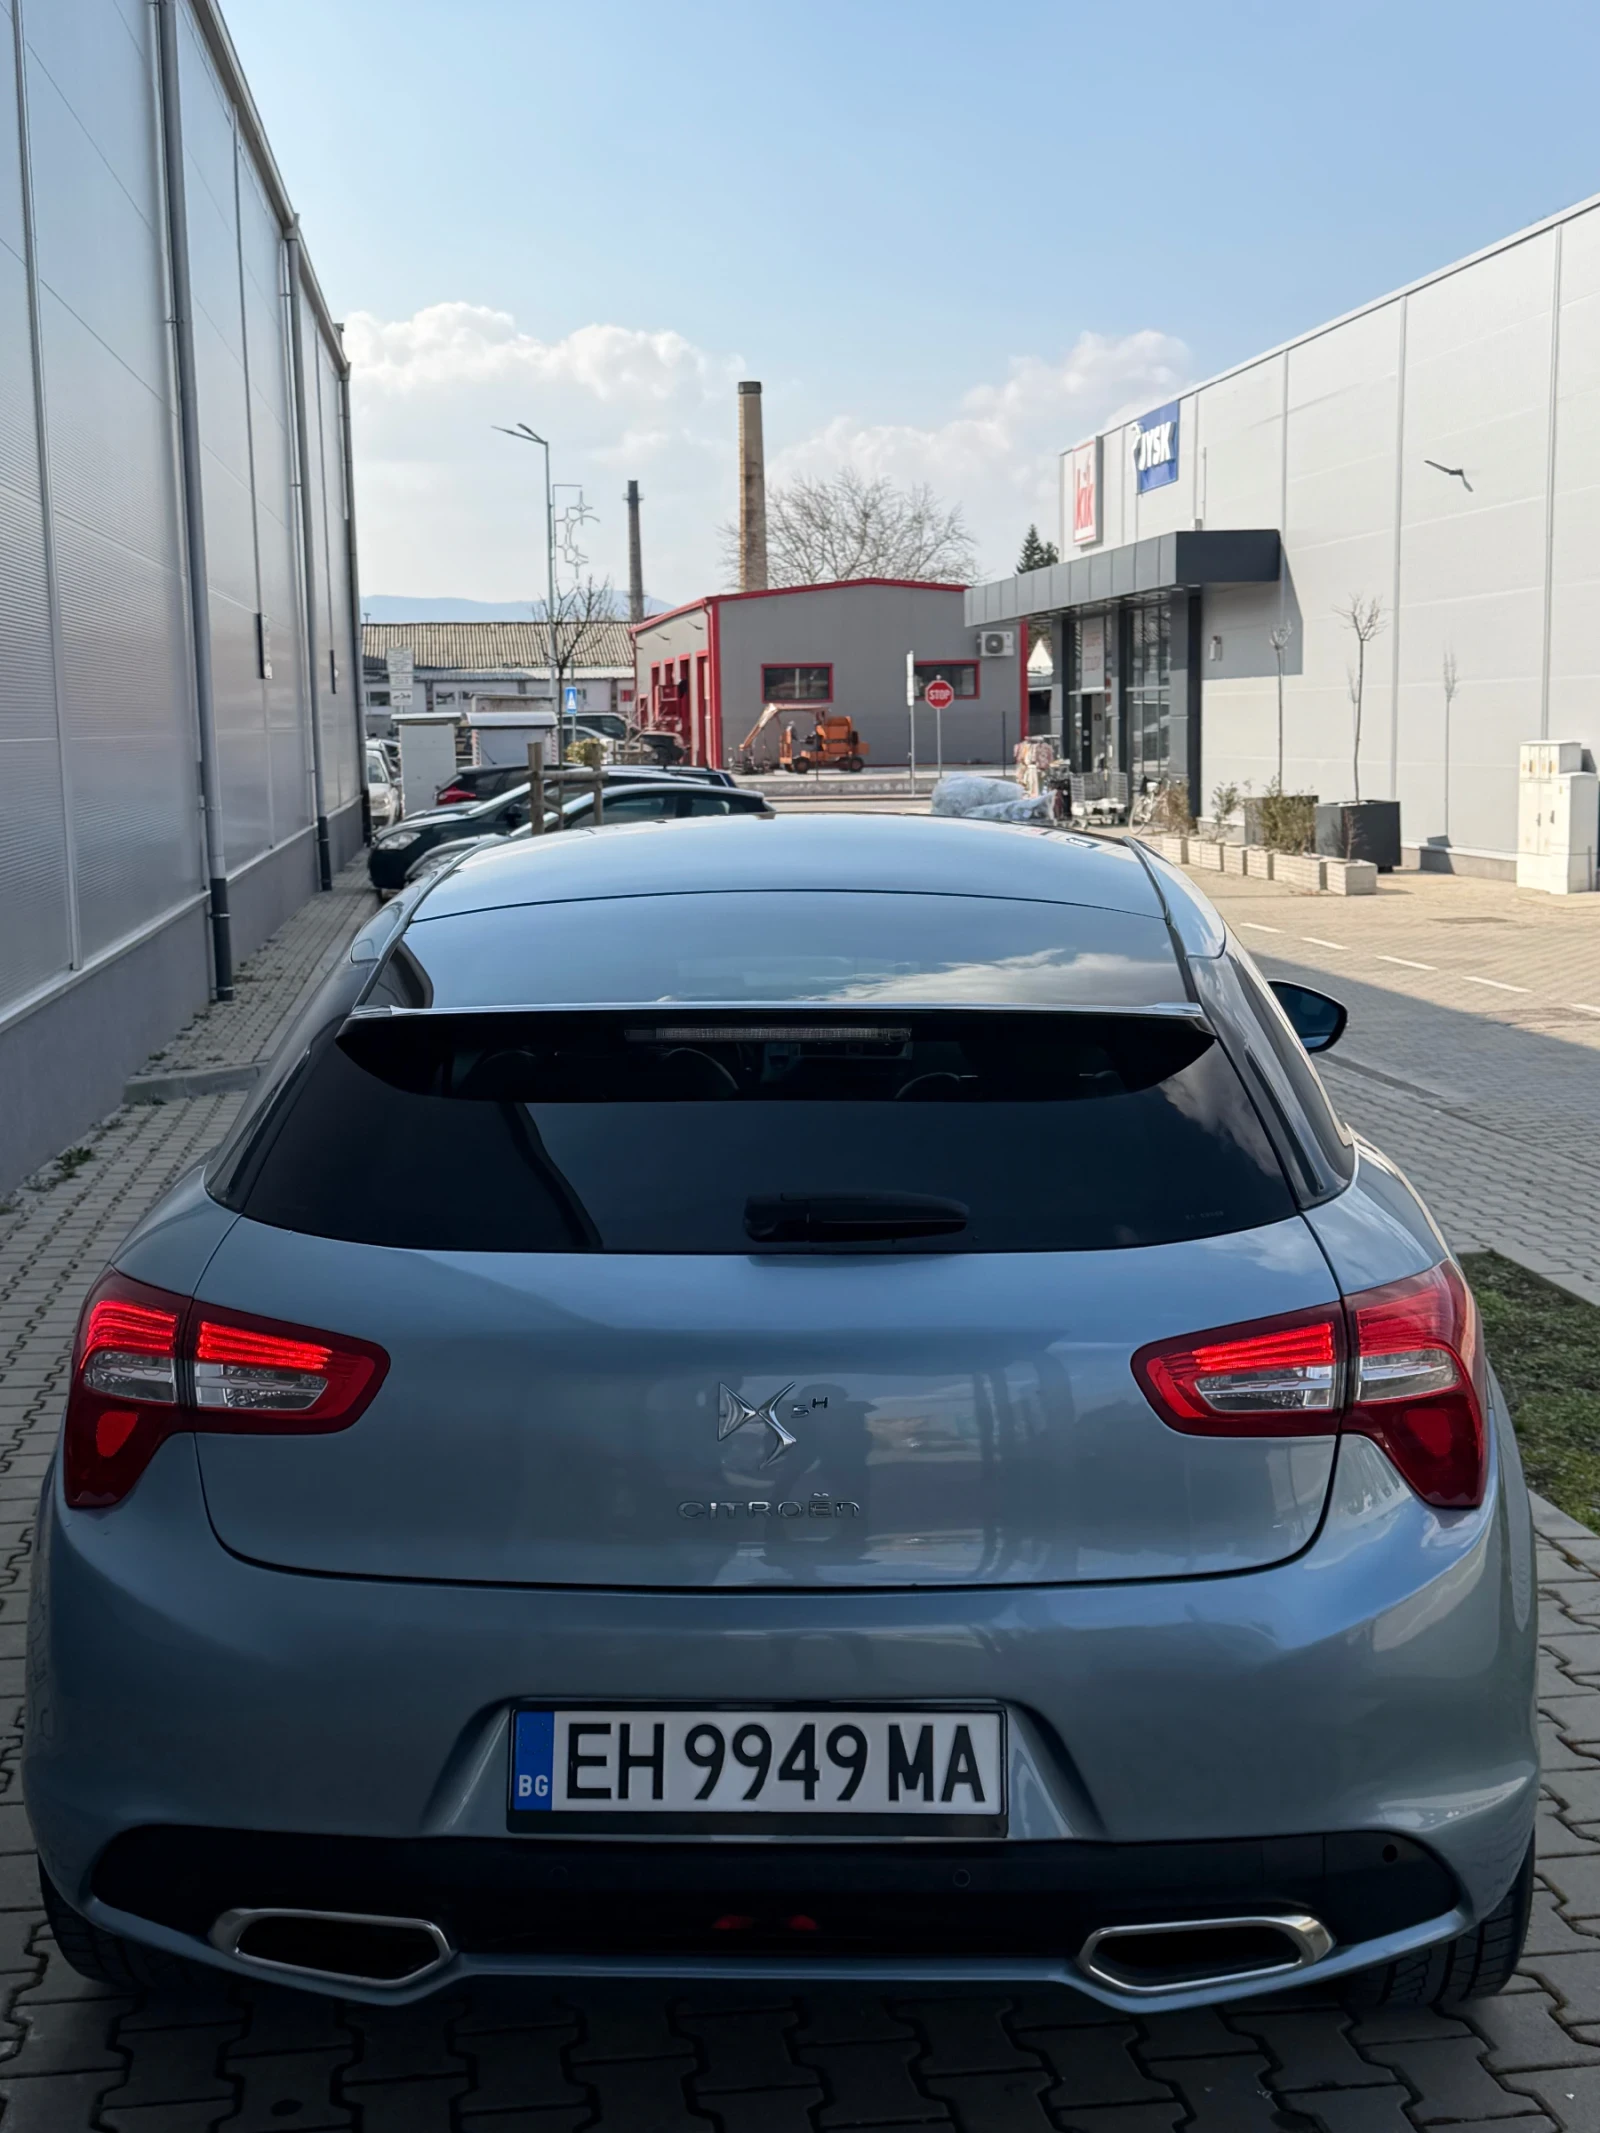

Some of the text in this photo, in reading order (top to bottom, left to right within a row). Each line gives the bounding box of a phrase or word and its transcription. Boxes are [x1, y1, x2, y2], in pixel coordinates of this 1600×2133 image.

[1138, 421, 1172, 470] JYSK
[929, 689, 950, 700] STOP
[566, 1722, 985, 1803] EH 9949 MA
[517, 1774, 548, 1796] BG
